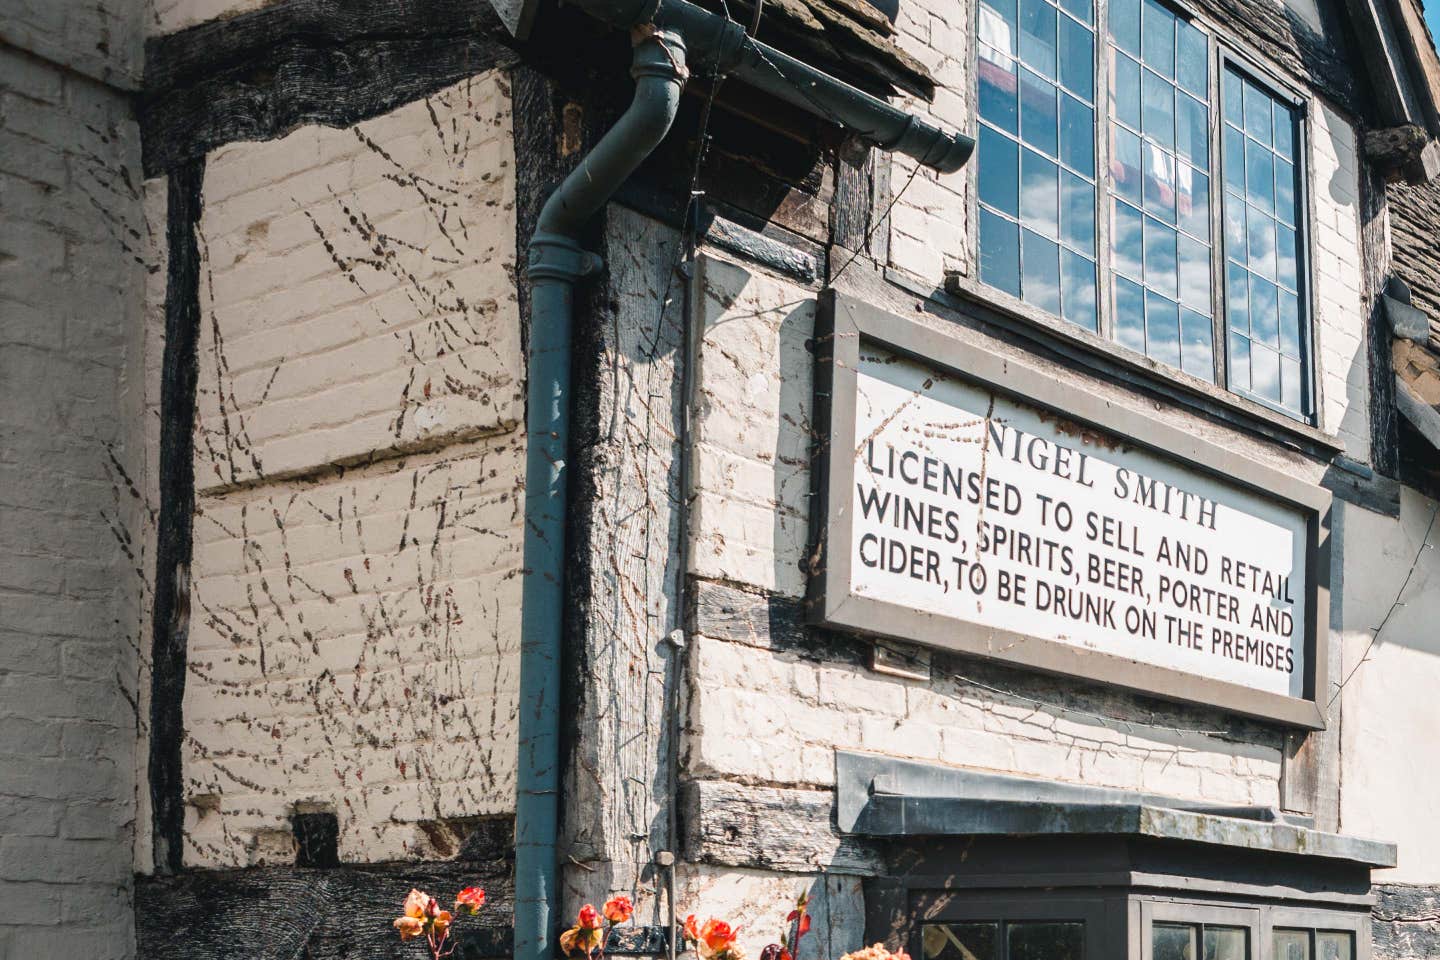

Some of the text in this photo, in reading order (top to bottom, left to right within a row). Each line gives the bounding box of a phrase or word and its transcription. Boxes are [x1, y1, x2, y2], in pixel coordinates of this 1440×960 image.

[867, 438, 1295, 605] LICENSED TO SELL AND RETAIL
[987, 420, 1217, 531] NIGEL SMITH
[857, 482, 1294, 638] WINES, SPIRITS, BEER, PORTER AND
[859, 532, 1294, 675] CIDER, TO BE DRUNK ON THE PREMISES
